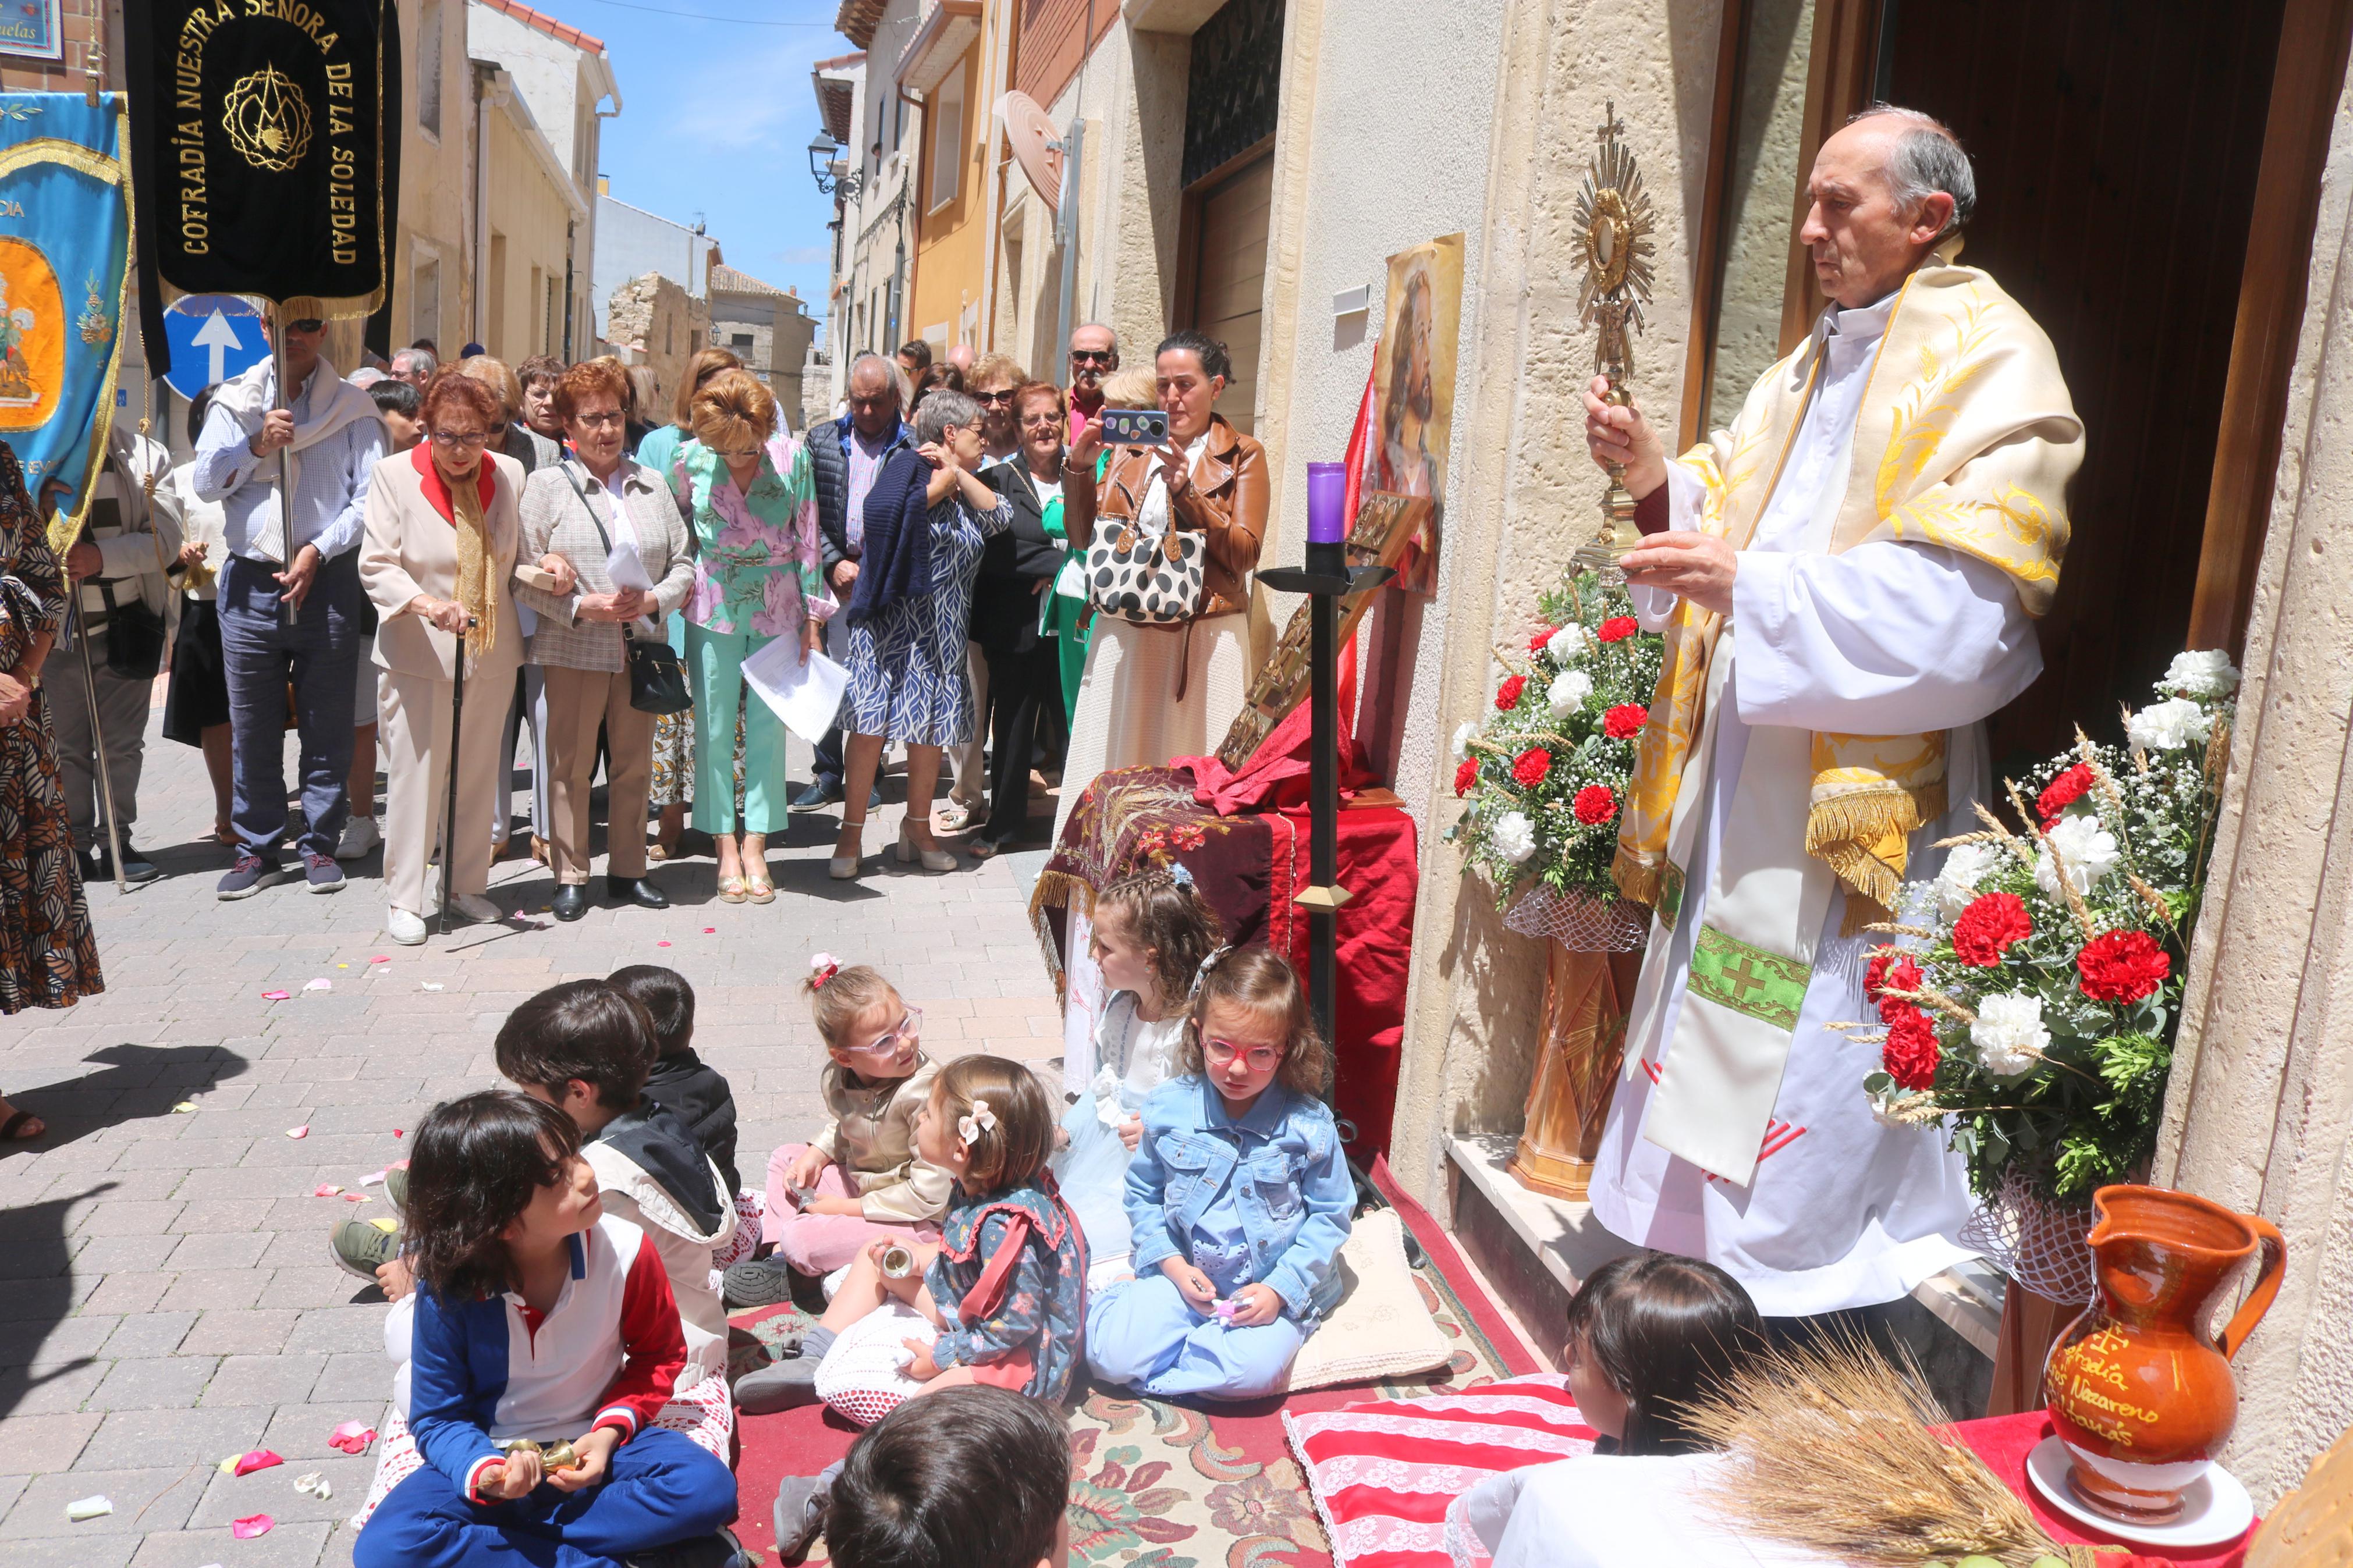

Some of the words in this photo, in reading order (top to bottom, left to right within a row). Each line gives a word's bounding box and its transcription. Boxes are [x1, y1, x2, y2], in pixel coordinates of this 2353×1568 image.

[176, 0, 236, 111] NUESTRA
[326, 62, 353, 98] DE
[329, 104, 354, 136] LA
[331, 146, 356, 264] SOLEDAD
[2070, 1374, 2159, 1423] Nazareno
